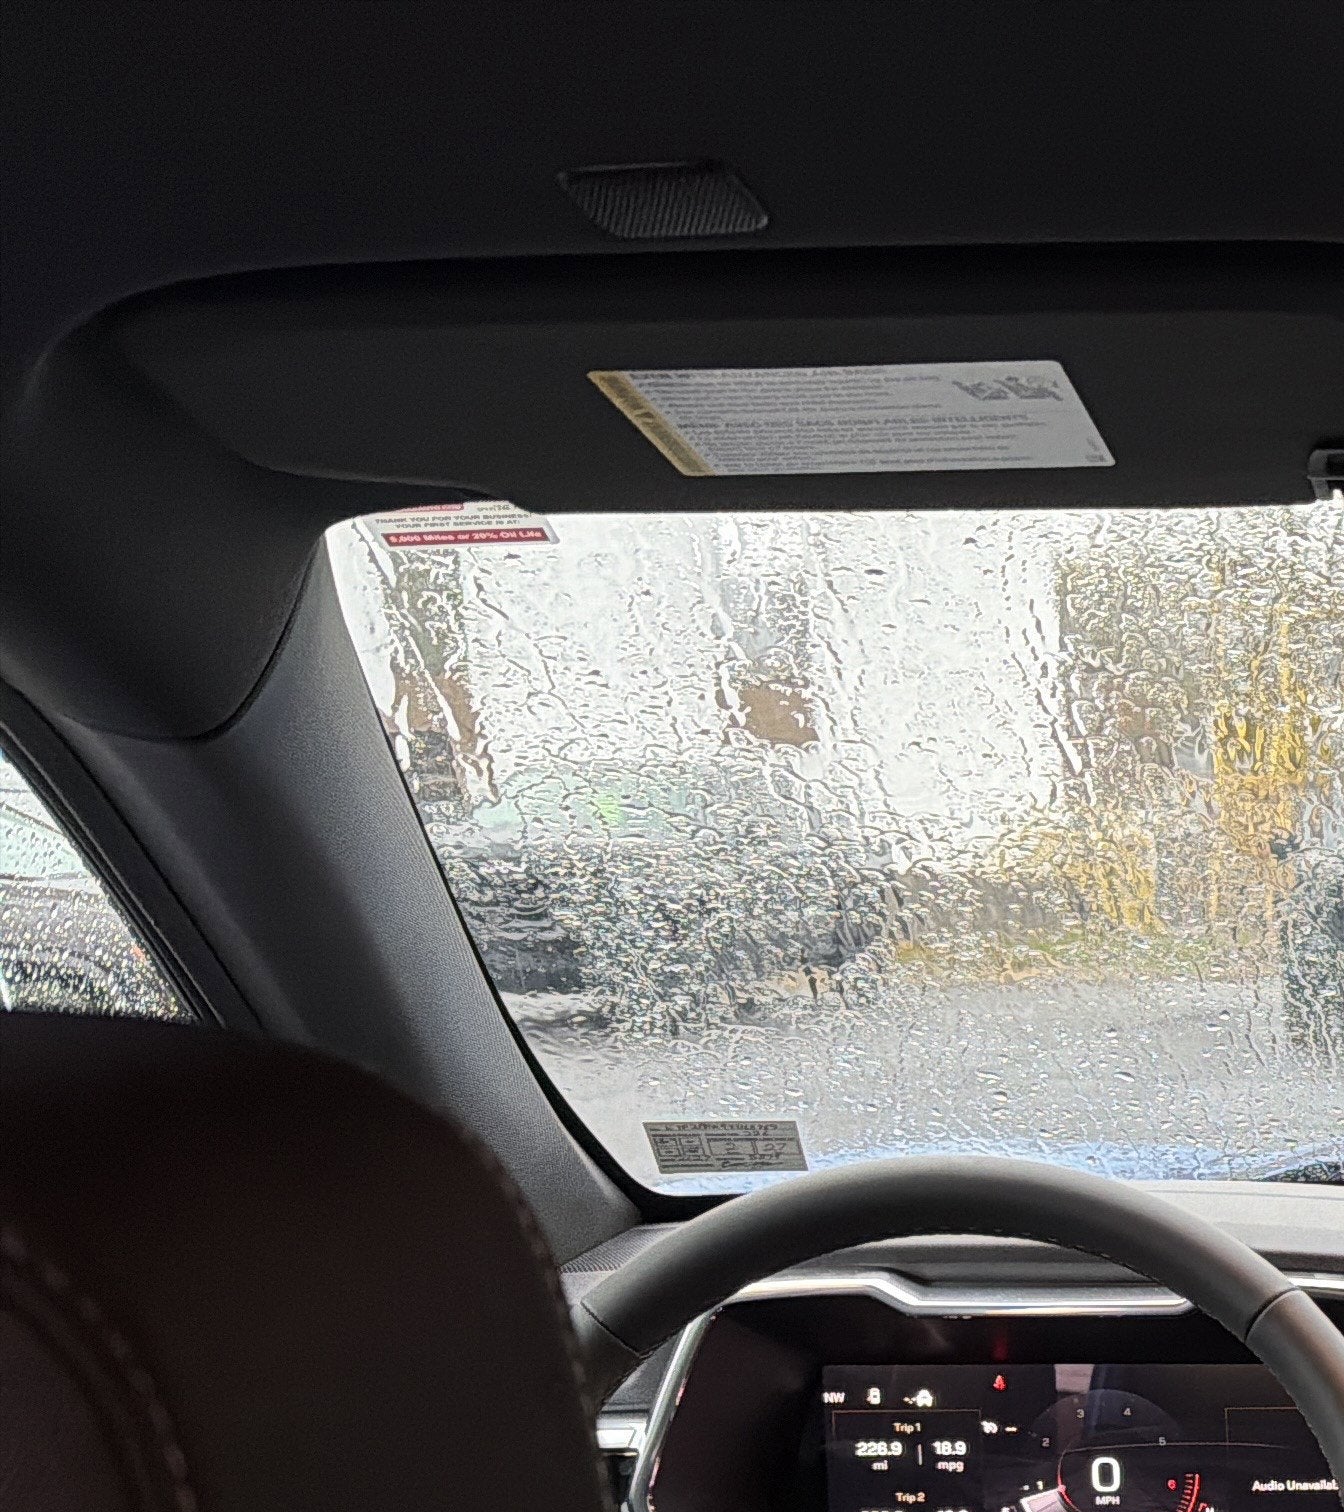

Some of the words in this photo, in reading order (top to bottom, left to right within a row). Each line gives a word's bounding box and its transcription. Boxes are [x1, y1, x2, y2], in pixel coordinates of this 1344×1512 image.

[424, 534, 455, 542] Miles
[499, 531, 517, 539] Oil
[519, 530, 542, 538] Life
[823, 1392, 845, 1403] NW
[1076, 1409, 1085, 1418] 3
[1123, 1407, 1131, 1416] 4
[894, 1422, 914, 1434] Trip
[915, 1422, 921, 1431] 1
[1042, 1438, 1050, 1447] 2
[1159, 1437, 1166, 1446] 5
[932, 1441, 967, 1455] 18.9
[872, 1460, 888, 1470] mi
[936, 1461, 964, 1472] mpg
[1091, 1457, 1121, 1492] 0
[1167, 1479, 1177, 1489] 6
[1252, 1480, 1285, 1491] Audio
[896, 1493, 916, 1504] Trip
[917, 1493, 926, 1502] 2
[1095, 1496, 1120, 1506] MPH
